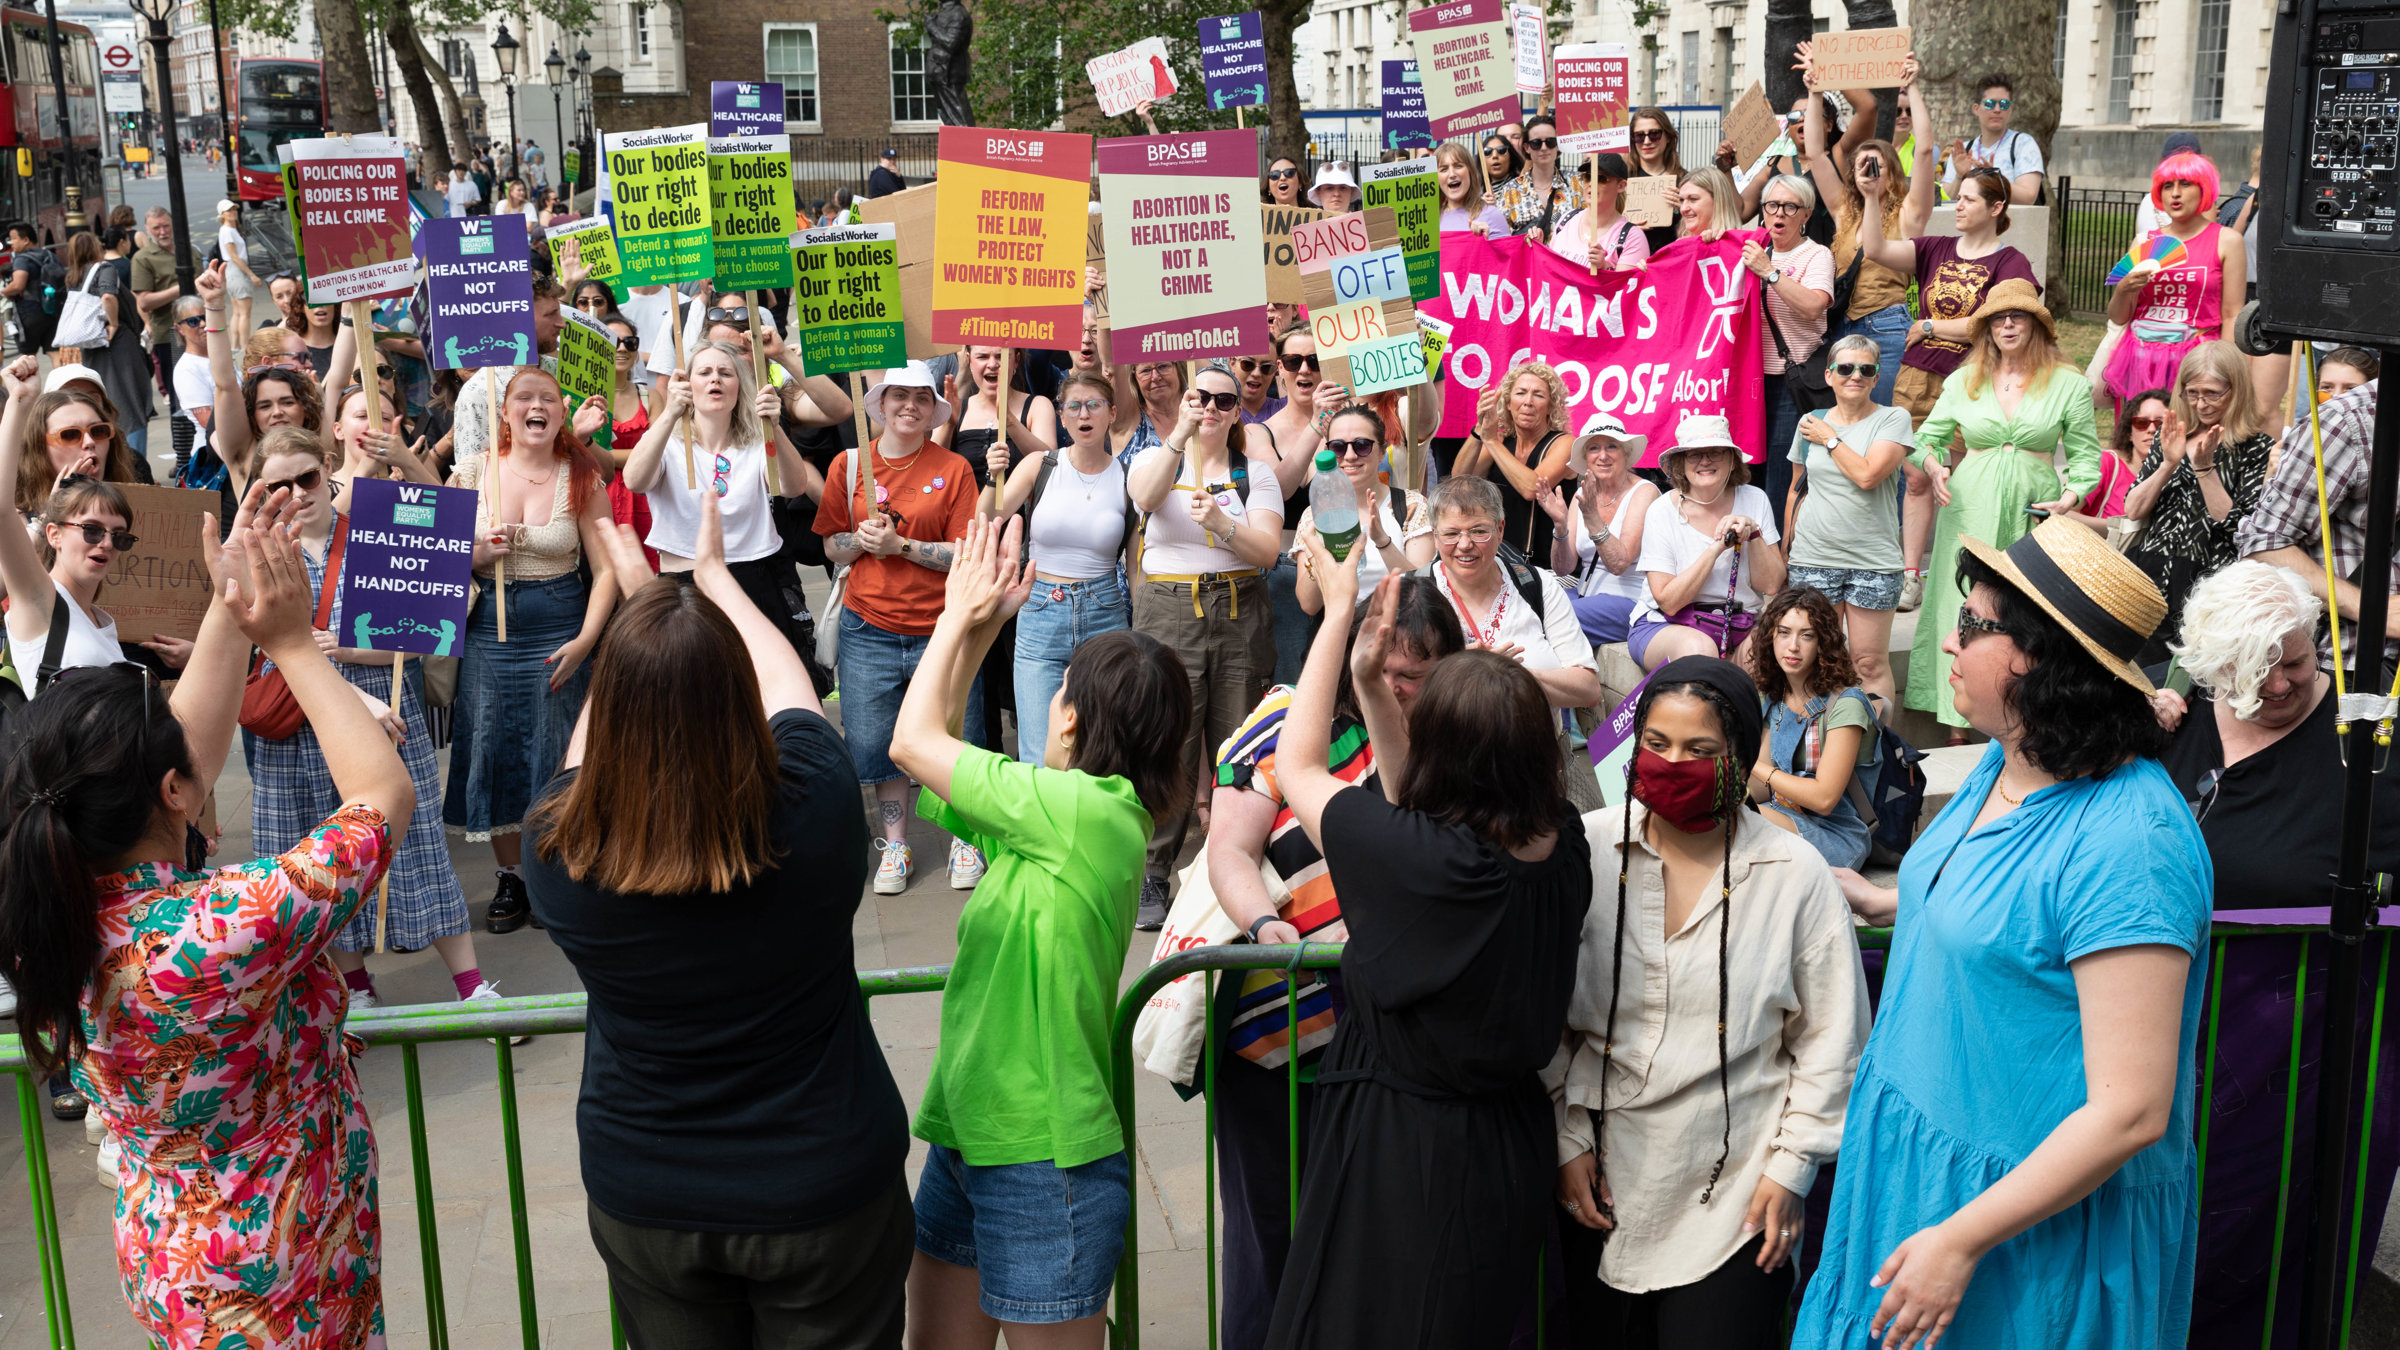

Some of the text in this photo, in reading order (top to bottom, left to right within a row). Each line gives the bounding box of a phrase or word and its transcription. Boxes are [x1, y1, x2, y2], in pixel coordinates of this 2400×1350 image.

[1437, 6, 1462, 21] BPAS
[1203, 40, 1262, 54] HEALTHCARE
[1433, 32, 1489, 55] ABORTION IS
[1819, 35, 1908, 54] NO FORCED
[1224, 54, 1243, 64] NOT
[1434, 49, 1494, 71] HEALTHCARE,
[1558, 62, 1622, 74] POLICING OUR
[1209, 64, 1264, 78] HANDCUFFS
[1453, 66, 1480, 82] NOT A
[1454, 80, 1485, 97] CRIME
[1558, 77, 1623, 88] BODIES IS THE
[1559, 92, 1614, 103] REAL CRIME
[714, 112, 782, 122] HEALTHCARE
[1448, 108, 1504, 132] #TimeToAct
[737, 126, 759, 135] NOT
[1559, 136, 1585, 144] ABORTION
[1592, 130, 1626, 140] HEALTHCARE
[987, 138, 1026, 156] BPAS
[1148, 142, 1190, 161] BPAS
[1576, 142, 1596, 150] DECRIM
[613, 148, 706, 177] Our bodies
[730, 157, 787, 180] bodies
[303, 165, 362, 181] POLICING
[366, 165, 396, 179] OUR
[305, 186, 399, 203] BODIES IS THE
[617, 175, 698, 204] Our right
[735, 185, 776, 211] right
[1366, 178, 1436, 206] Our bodies
[982, 190, 1045, 212] REFORM
[1133, 193, 1230, 219] ABORTION IS
[306, 208, 386, 226] REAL CRIME
[621, 202, 701, 231] to decide
[726, 212, 781, 235] decide
[1398, 204, 1427, 230] right
[977, 215, 1046, 240] THE LAW,
[1131, 220, 1236, 246] HEALTHCARE,
[625, 232, 707, 253] Defend a woman's
[740, 241, 790, 256] a woman's
[1294, 219, 1366, 262] BANS
[1401, 229, 1430, 252] ecide
[580, 246, 606, 263] right
[797, 245, 893, 272] Our bodies
[978, 240, 1044, 262] PROTECT
[1162, 248, 1208, 270] NOT A
[430, 260, 528, 276] HEALTHCARE
[627, 252, 700, 272] right to choose
[732, 260, 780, 273] to choose
[312, 263, 409, 290] ABORTION IS HEALTHCARE
[800, 271, 881, 298] Our right
[943, 263, 1076, 289] WOMEN'S RIGHTS
[1161, 274, 1213, 296] CRIME
[1338, 254, 1399, 298] OFF
[2148, 272, 2196, 282] RACE
[337, 281, 386, 297] DECRIM NOW!
[465, 282, 496, 294] NOT
[2154, 284, 2187, 295] FOR
[439, 300, 529, 316] HANDCUFFS
[803, 297, 886, 324] to decide
[2154, 297, 2187, 307] LIFE
[2148, 308, 2185, 320] 2021
[806, 326, 895, 344] Defend a woman's
[960, 317, 1054, 340] #TimeToAct
[1317, 305, 1384, 347] OUR
[564, 322, 614, 365] Our bodies
[1141, 326, 1240, 353] #TimeToAct
[807, 343, 884, 361] right to choose
[562, 343, 608, 383] Our right
[1349, 341, 1425, 386] BODIES
[560, 366, 572, 386] to
[396, 511, 432, 520] EQUALITY
[351, 529, 472, 554] HEALTHCARE
[390, 556, 429, 572] NOT
[354, 575, 465, 598] HANDCUFFS
